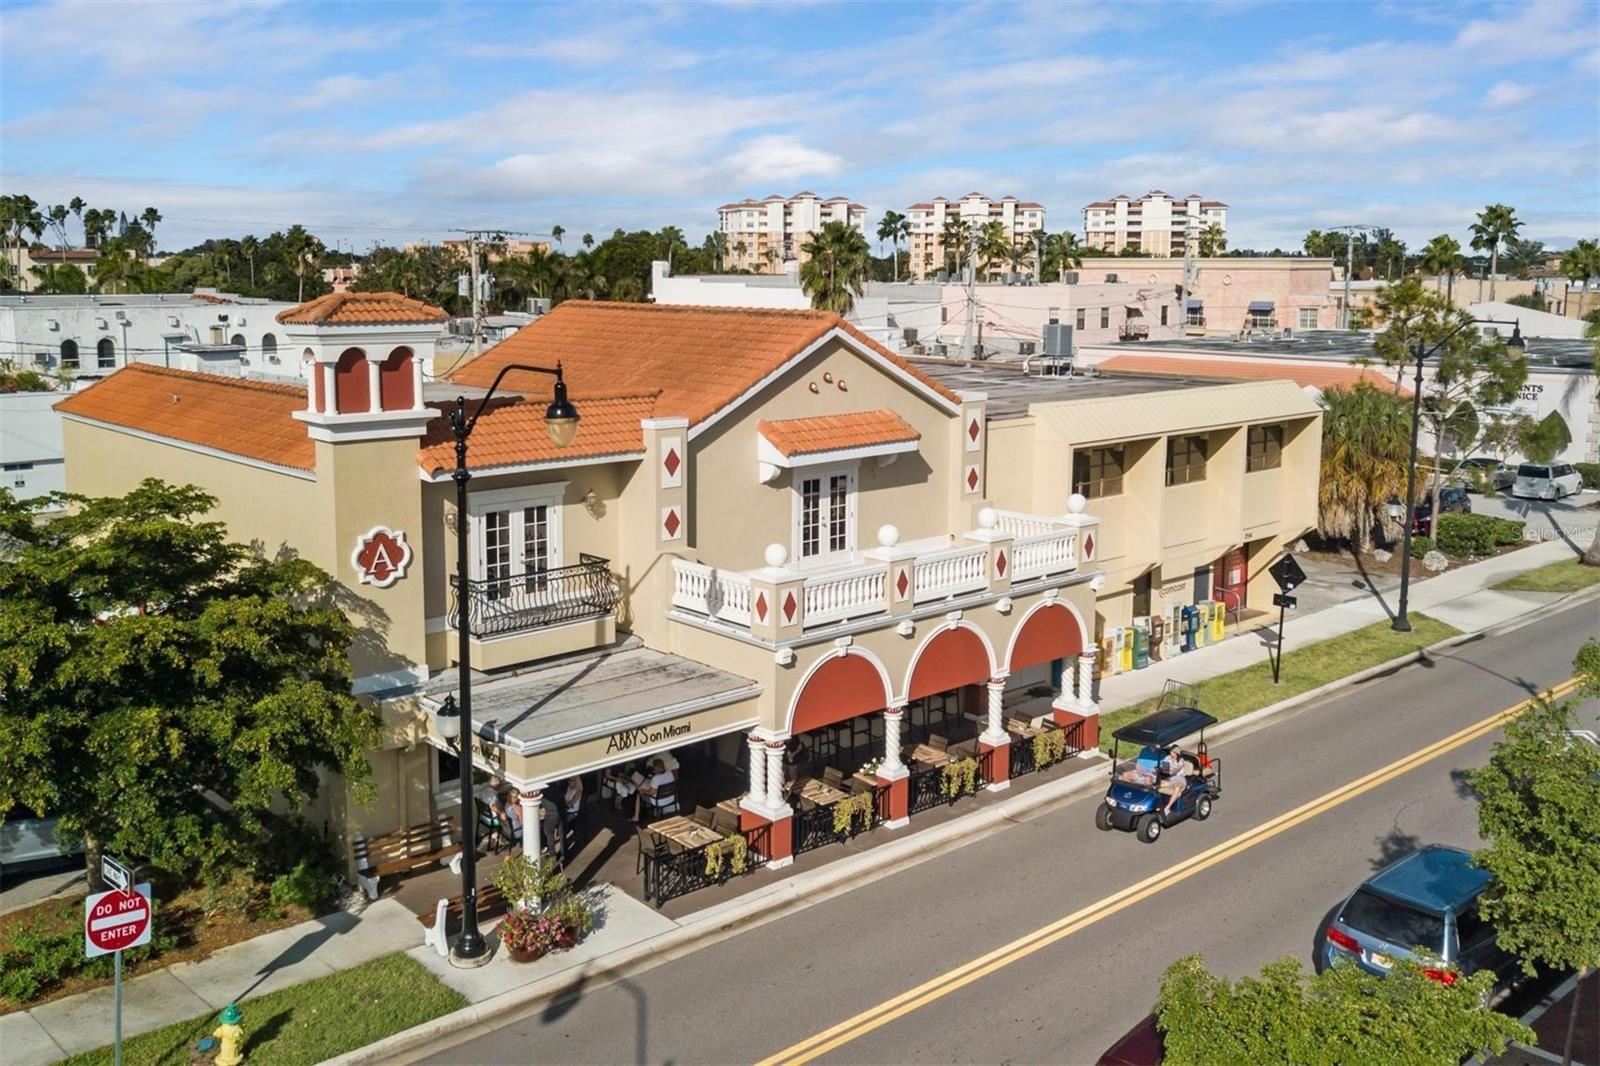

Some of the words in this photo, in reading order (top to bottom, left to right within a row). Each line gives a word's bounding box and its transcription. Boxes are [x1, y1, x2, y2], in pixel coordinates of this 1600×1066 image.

[368, 543, 396, 573] A
[650, 734, 662, 742] on
[663, 722, 691, 740] Miami
[96, 904, 112, 916] DO
[119, 897, 141, 911] NOT
[100, 925, 136, 942] ENTER
